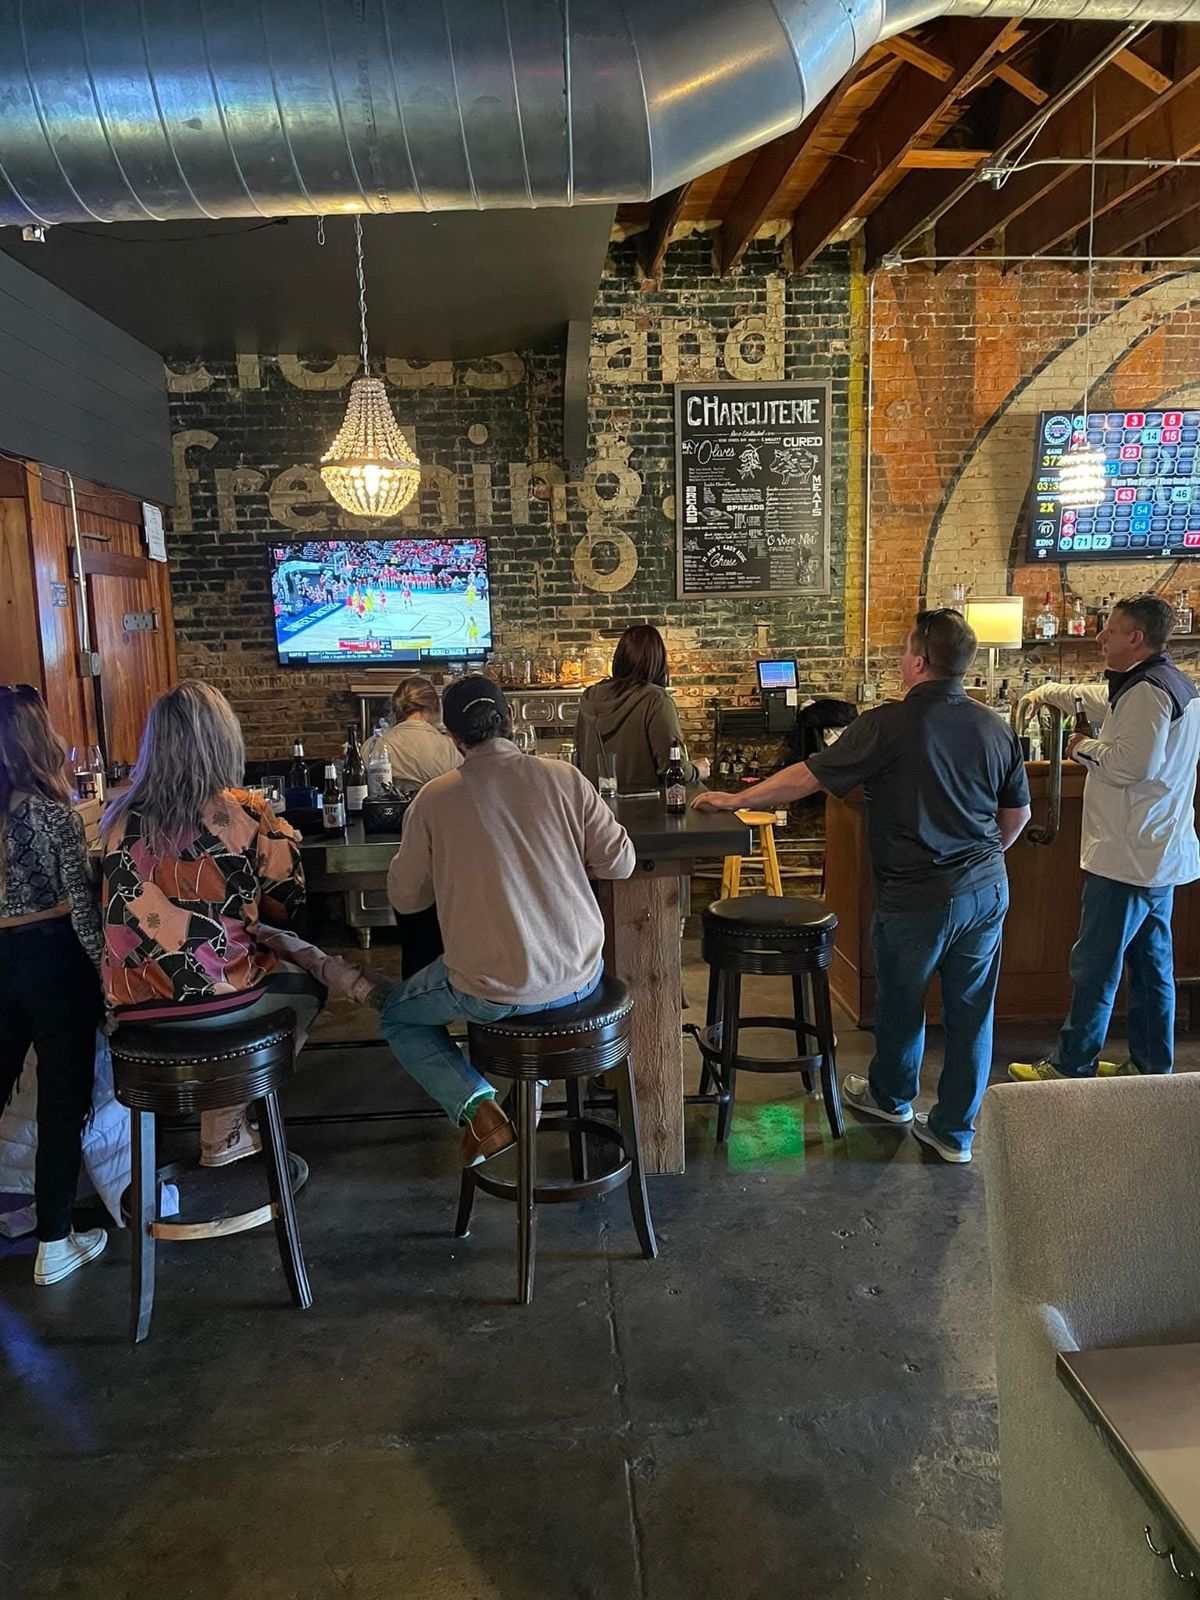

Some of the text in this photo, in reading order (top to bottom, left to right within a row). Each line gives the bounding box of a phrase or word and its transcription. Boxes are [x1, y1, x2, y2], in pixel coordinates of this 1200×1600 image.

[589, 278, 785, 381] and
[687, 396, 820, 426] CHARCUTERIE
[1131, 416, 1139, 425] 3
[1146, 432, 1157, 441] 14
[783, 436, 823, 448] CURED
[698, 440, 736, 465] Olives
[1124, 448, 1137, 457] 23
[1037, 482, 1060, 491] 03:3
[811, 475, 822, 517] MEATS
[1119, 490, 1132, 500] 43
[1176, 489, 1188, 498] 46
[726, 504, 765, 512] SPREADS
[1040, 503, 1055, 513] 2X
[1136, 506, 1148, 515] 54
[1134, 522, 1146, 530] 64
[1077, 538, 1088, 546] 71
[1096, 538, 1107, 546] 72
[1188, 535, 1200, 545] 77
